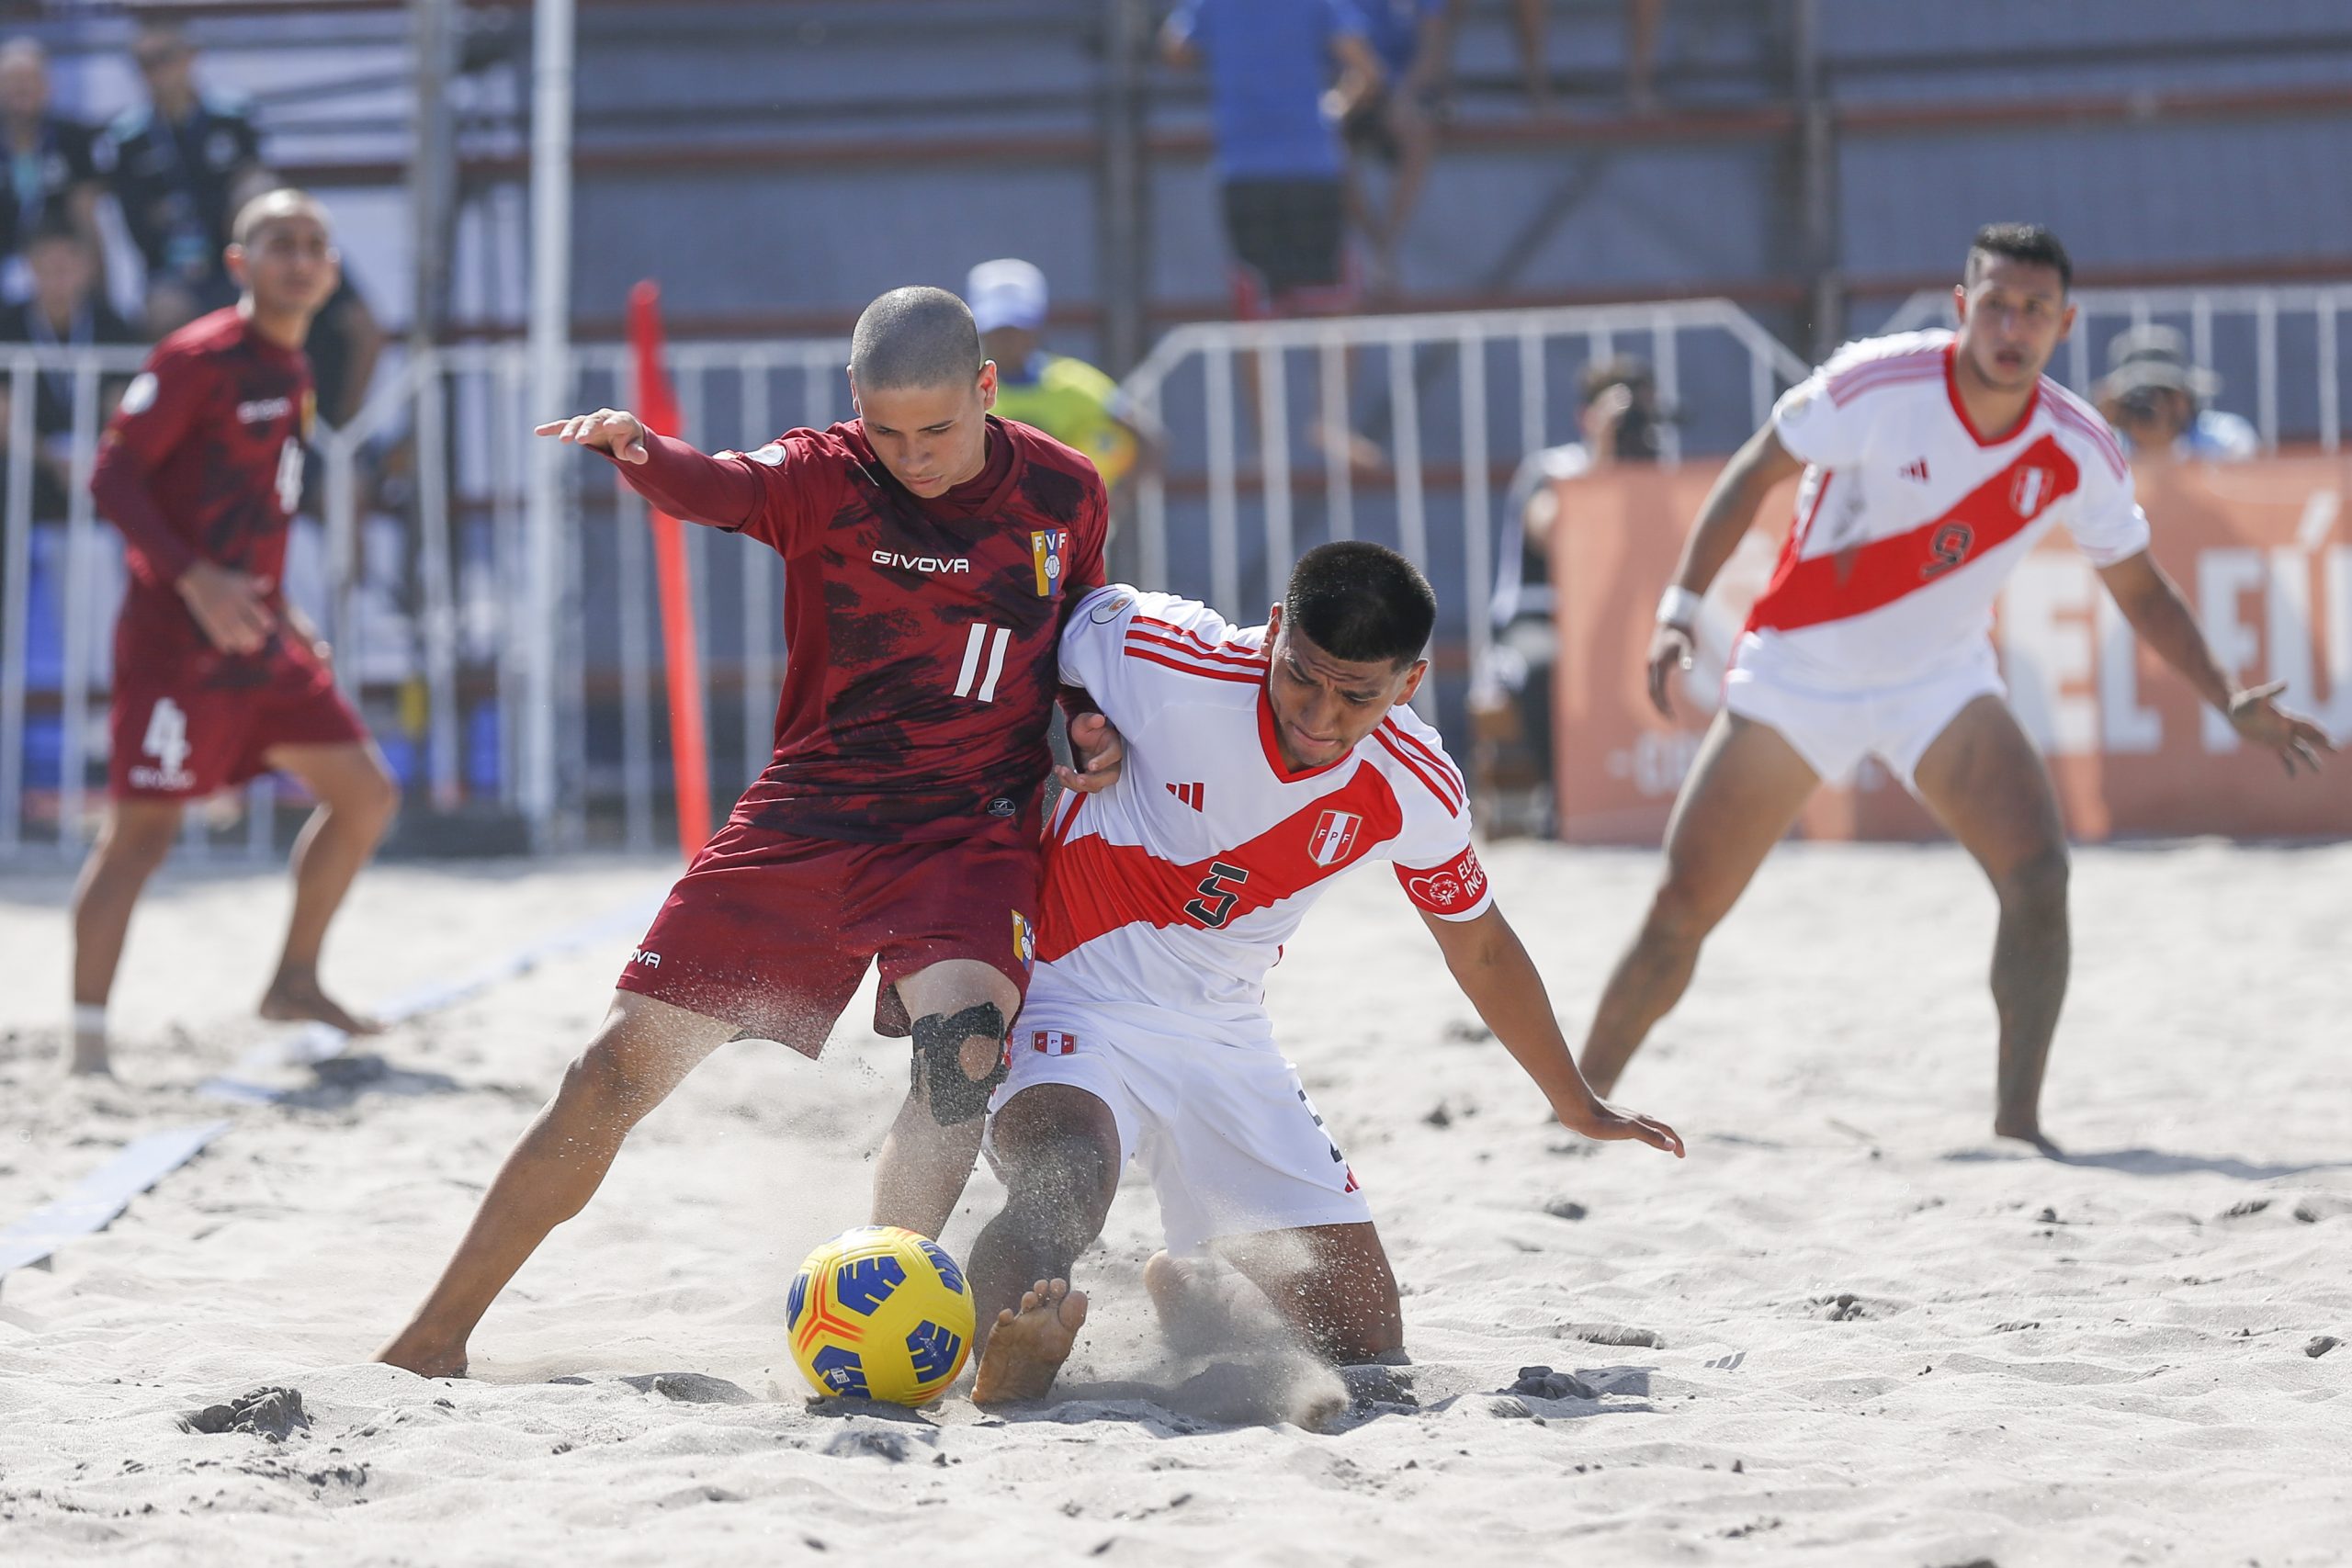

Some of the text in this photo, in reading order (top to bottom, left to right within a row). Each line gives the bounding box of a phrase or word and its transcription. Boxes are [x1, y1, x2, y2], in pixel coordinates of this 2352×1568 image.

[275, 435, 306, 514] 4
[872, 550, 969, 573] GIVOVA
[1035, 533, 1067, 552] FVF
[1921, 522, 1973, 581] 9
[953, 623, 1012, 703] 11
[2003, 553, 2161, 754] EL
[141, 697, 192, 773] 4
[1317, 829, 1351, 844] FPF
[1183, 861, 1250, 928] 5
